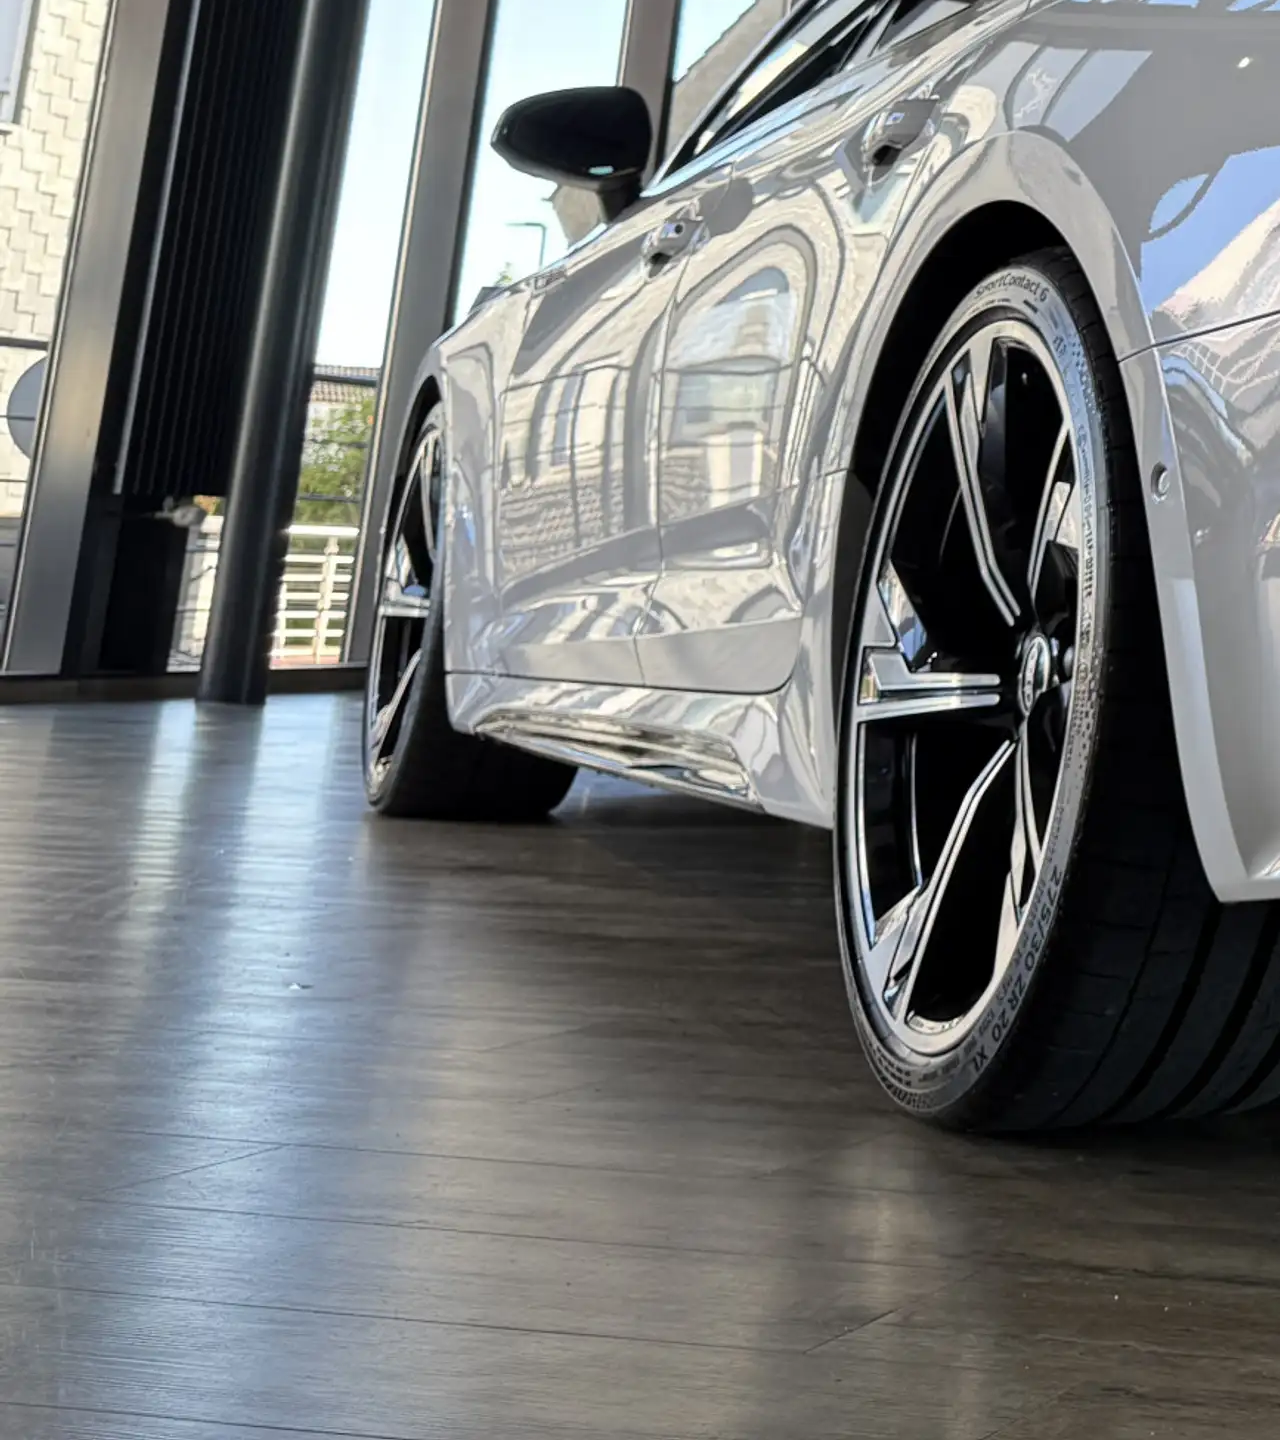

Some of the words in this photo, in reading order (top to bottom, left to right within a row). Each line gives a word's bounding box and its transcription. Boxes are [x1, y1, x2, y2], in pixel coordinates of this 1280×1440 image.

[1039, 287, 1050, 302] 6
[1024, 865, 1063, 972] 275/30
[972, 1044, 990, 1073] XL
